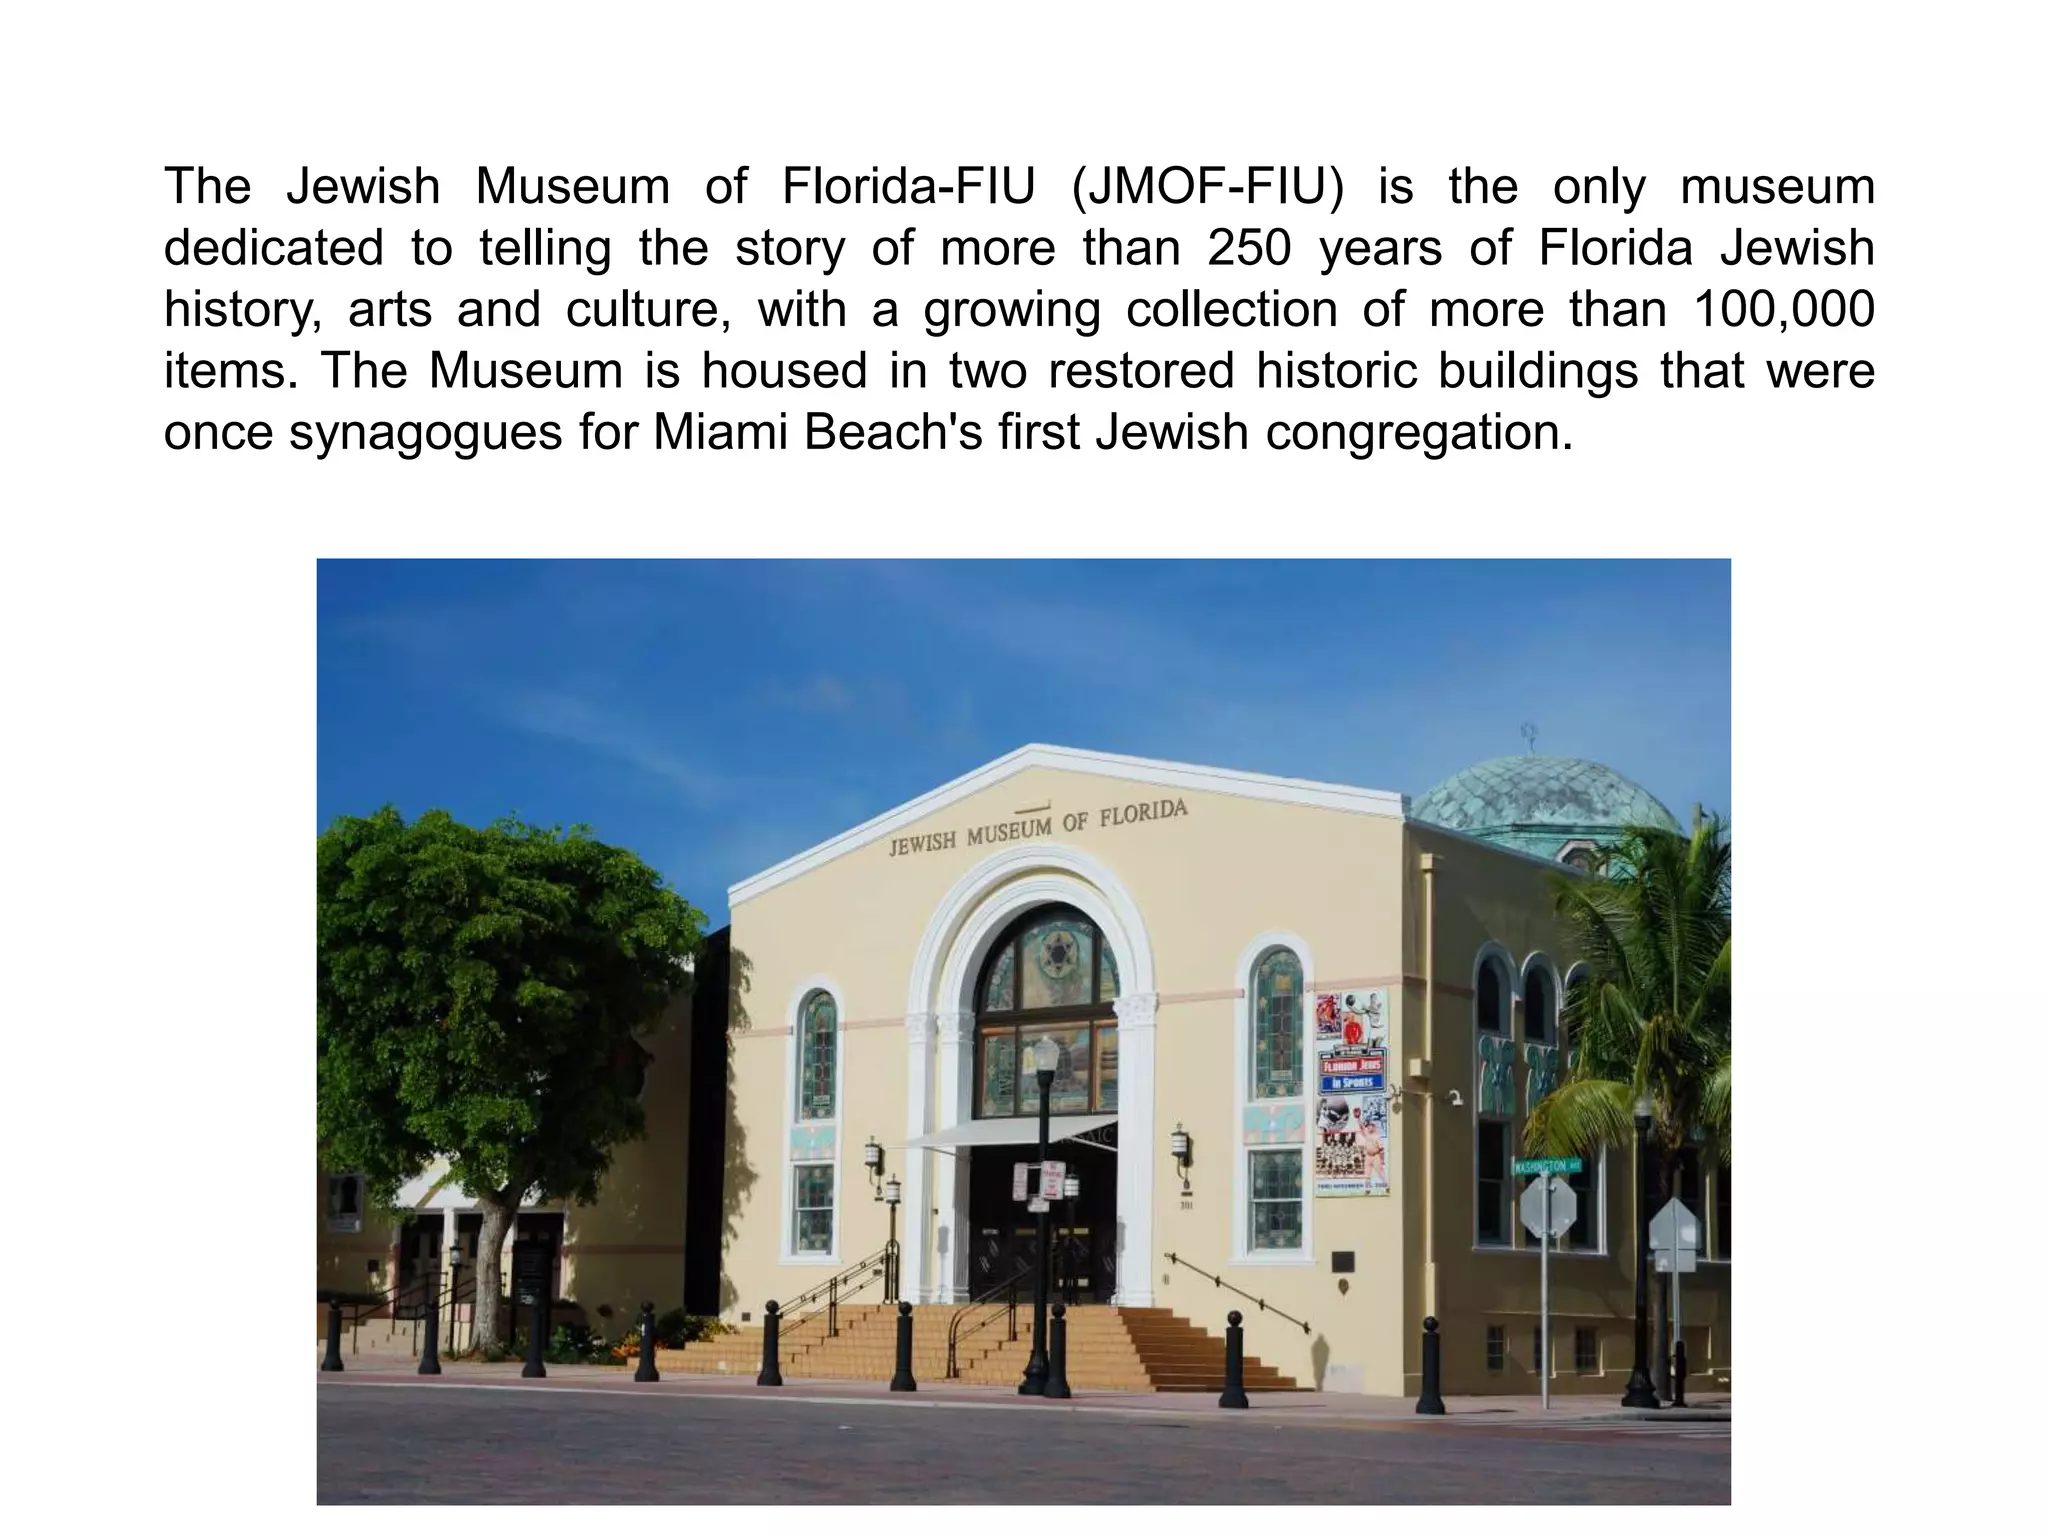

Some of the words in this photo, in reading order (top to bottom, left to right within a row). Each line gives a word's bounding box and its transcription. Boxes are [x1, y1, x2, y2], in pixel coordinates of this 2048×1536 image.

[889, 831, 957, 857] JEWISH
[967, 817, 1052, 846] MUSEUM
[1063, 812, 1089, 832] OF
[1100, 797, 1188, 827] FLORIDA
[1515, 1160, 1566, 1174] WASHINGTON
